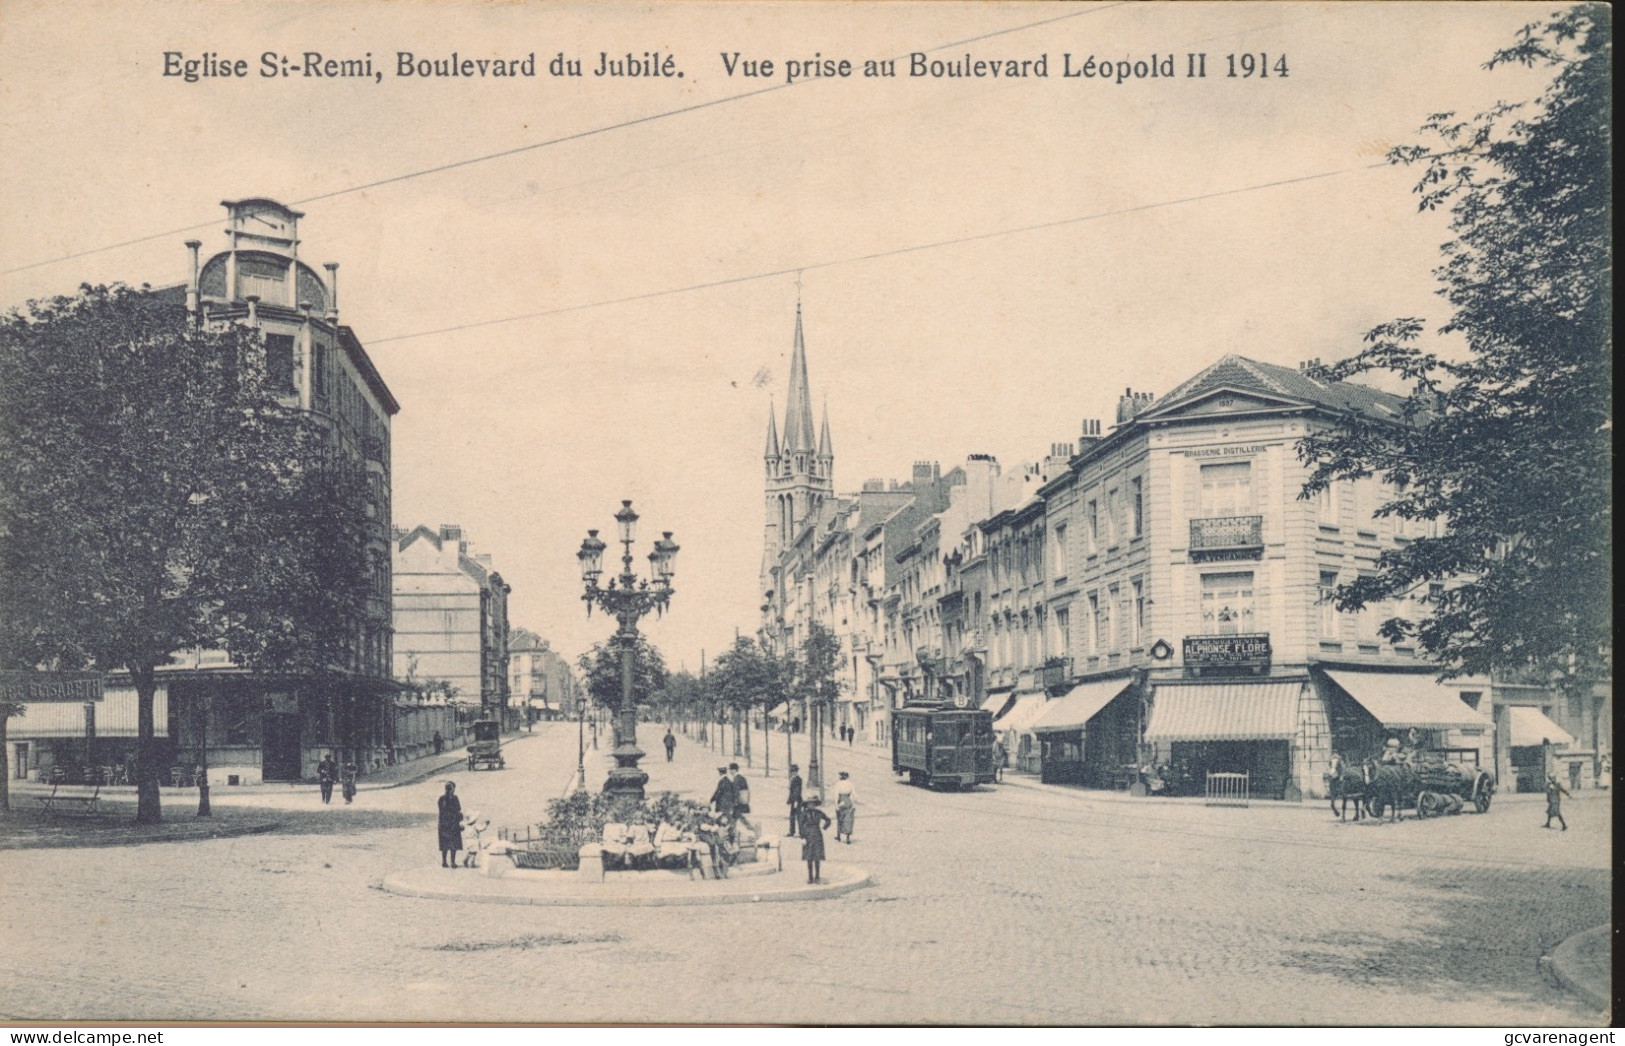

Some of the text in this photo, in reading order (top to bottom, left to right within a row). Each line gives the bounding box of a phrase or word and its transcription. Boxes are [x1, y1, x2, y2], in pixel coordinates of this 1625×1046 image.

[1184, 446, 1267, 457] BRASSERIE DISTILLERIE
[1185, 645, 1230, 655] ALPHONSE
[1235, 643, 1268, 653] FLORE
